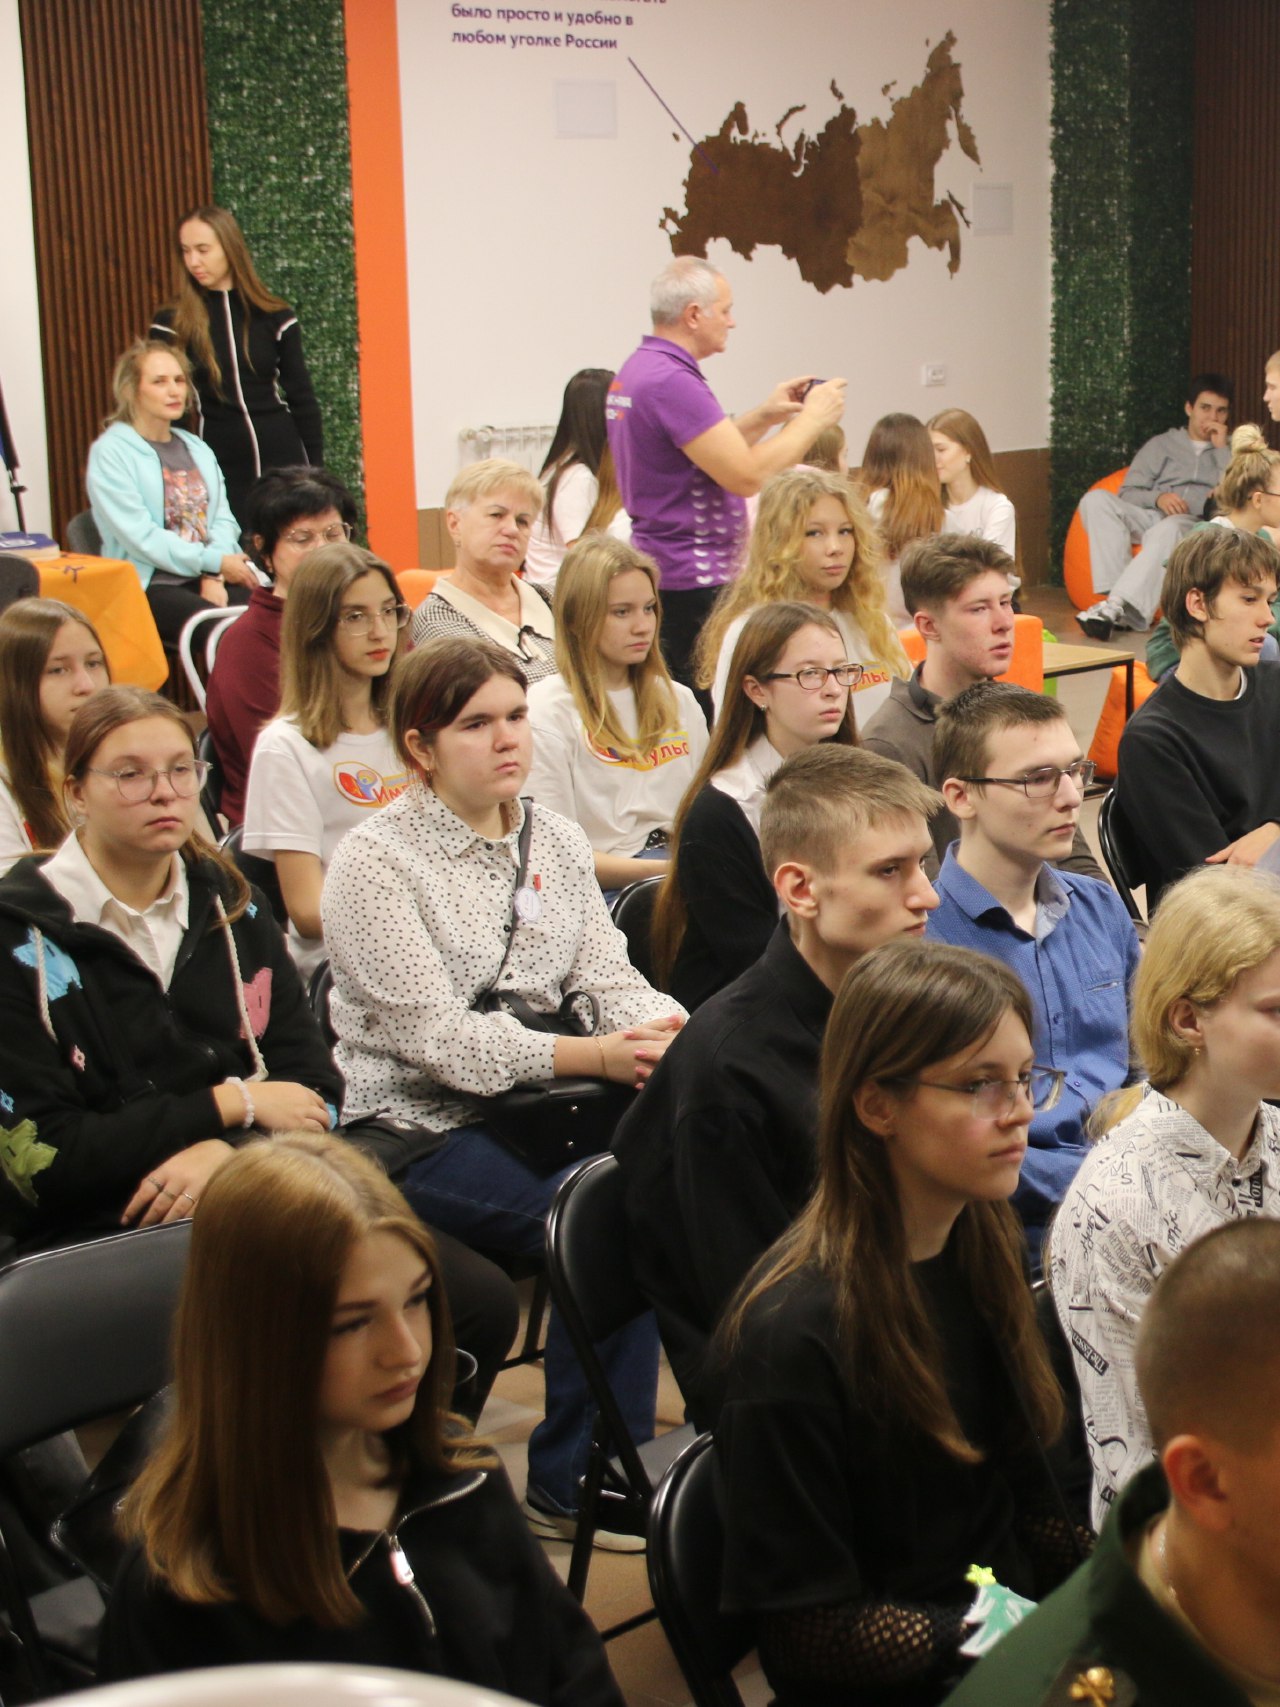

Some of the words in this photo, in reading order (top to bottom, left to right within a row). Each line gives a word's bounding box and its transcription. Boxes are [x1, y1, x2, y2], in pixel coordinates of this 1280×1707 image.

[451, 4, 492, 18] было
[497, 8, 550, 23] просто
[554, 11, 563, 22] и
[567, 11, 622, 26] удобно
[625, 15, 633, 26] в
[452, 29, 506, 44] любом
[510, 34, 561, 49] уголке
[565, 34, 617, 49] России
